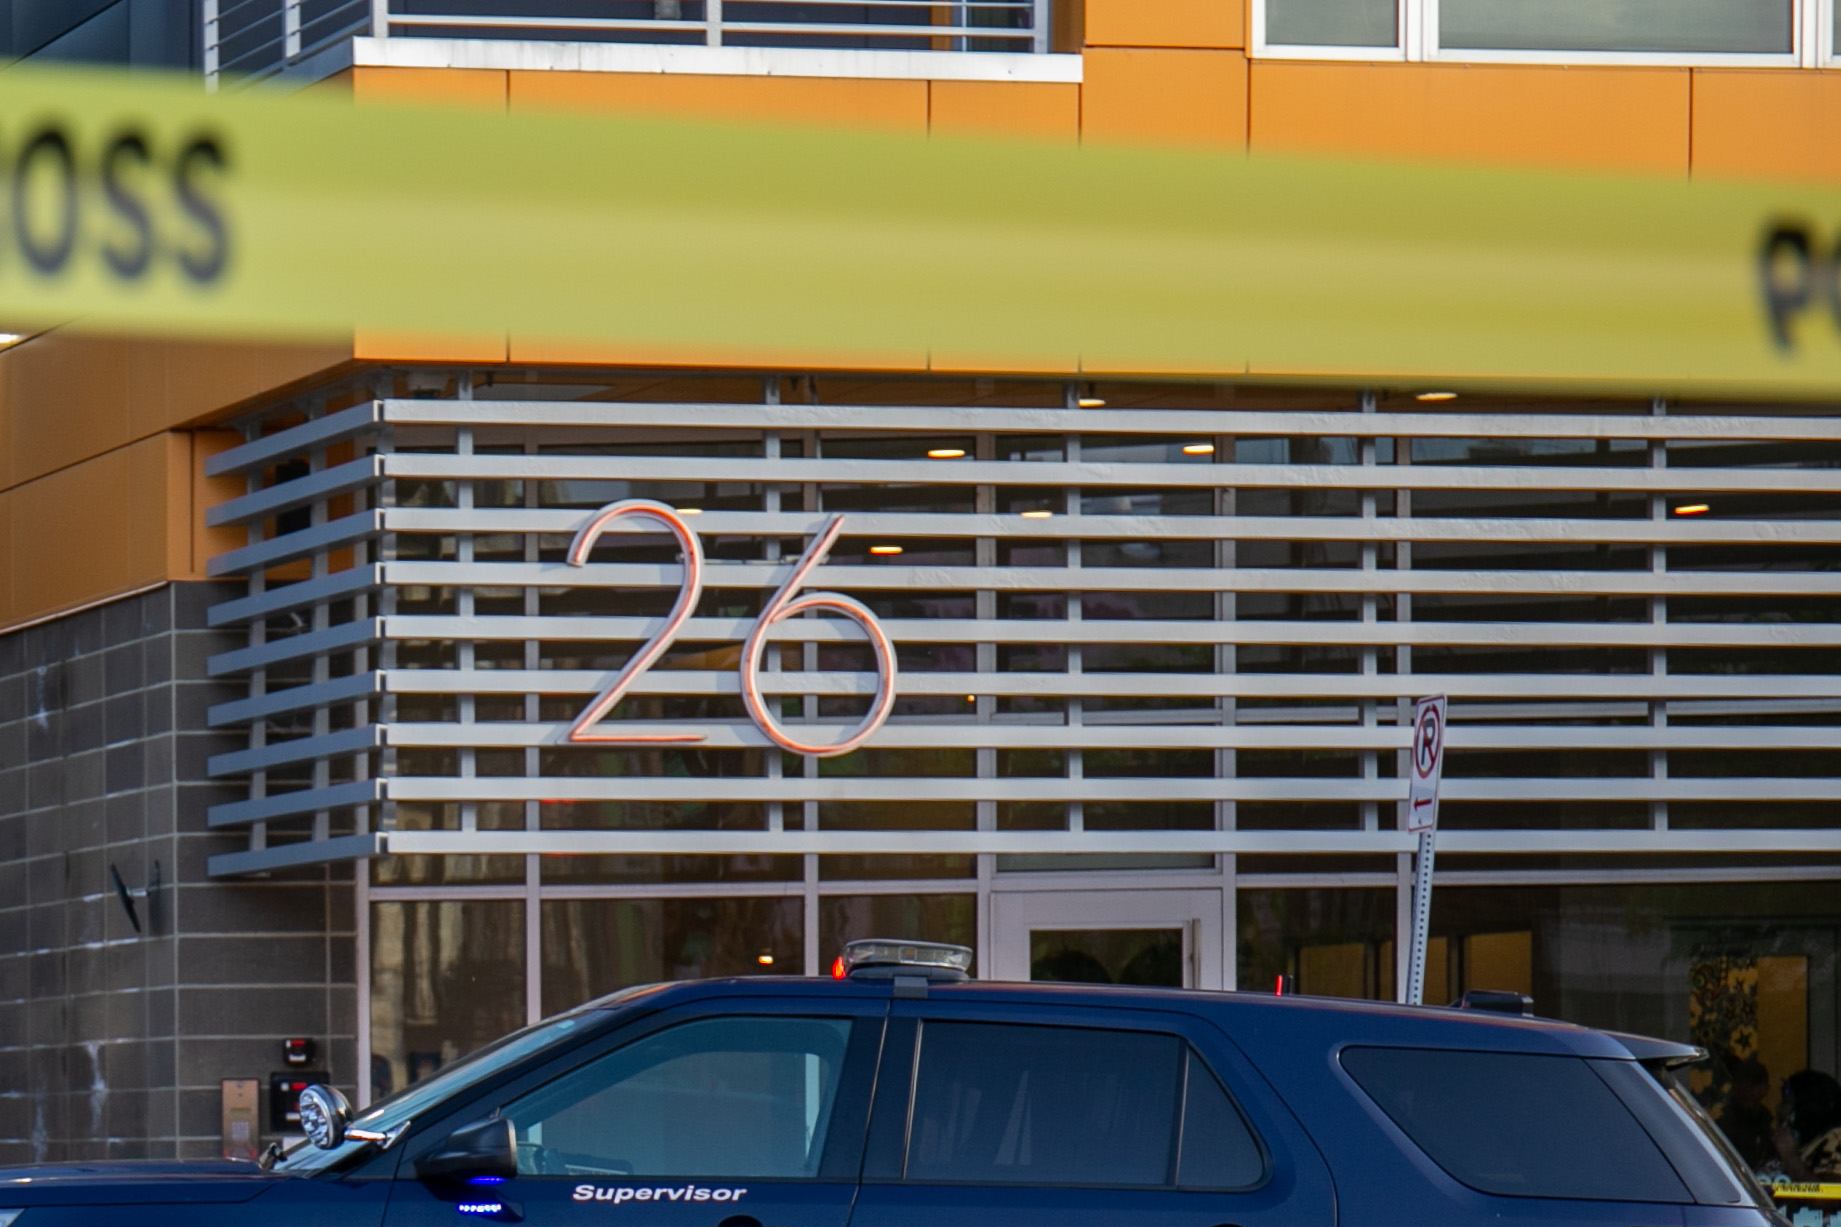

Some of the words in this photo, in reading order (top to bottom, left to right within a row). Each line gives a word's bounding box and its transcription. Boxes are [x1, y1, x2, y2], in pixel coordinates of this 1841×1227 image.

[1757, 217, 1841, 354] P
[565, 498, 897, 757] 26
[572, 1184, 748, 1205] Supervisor
